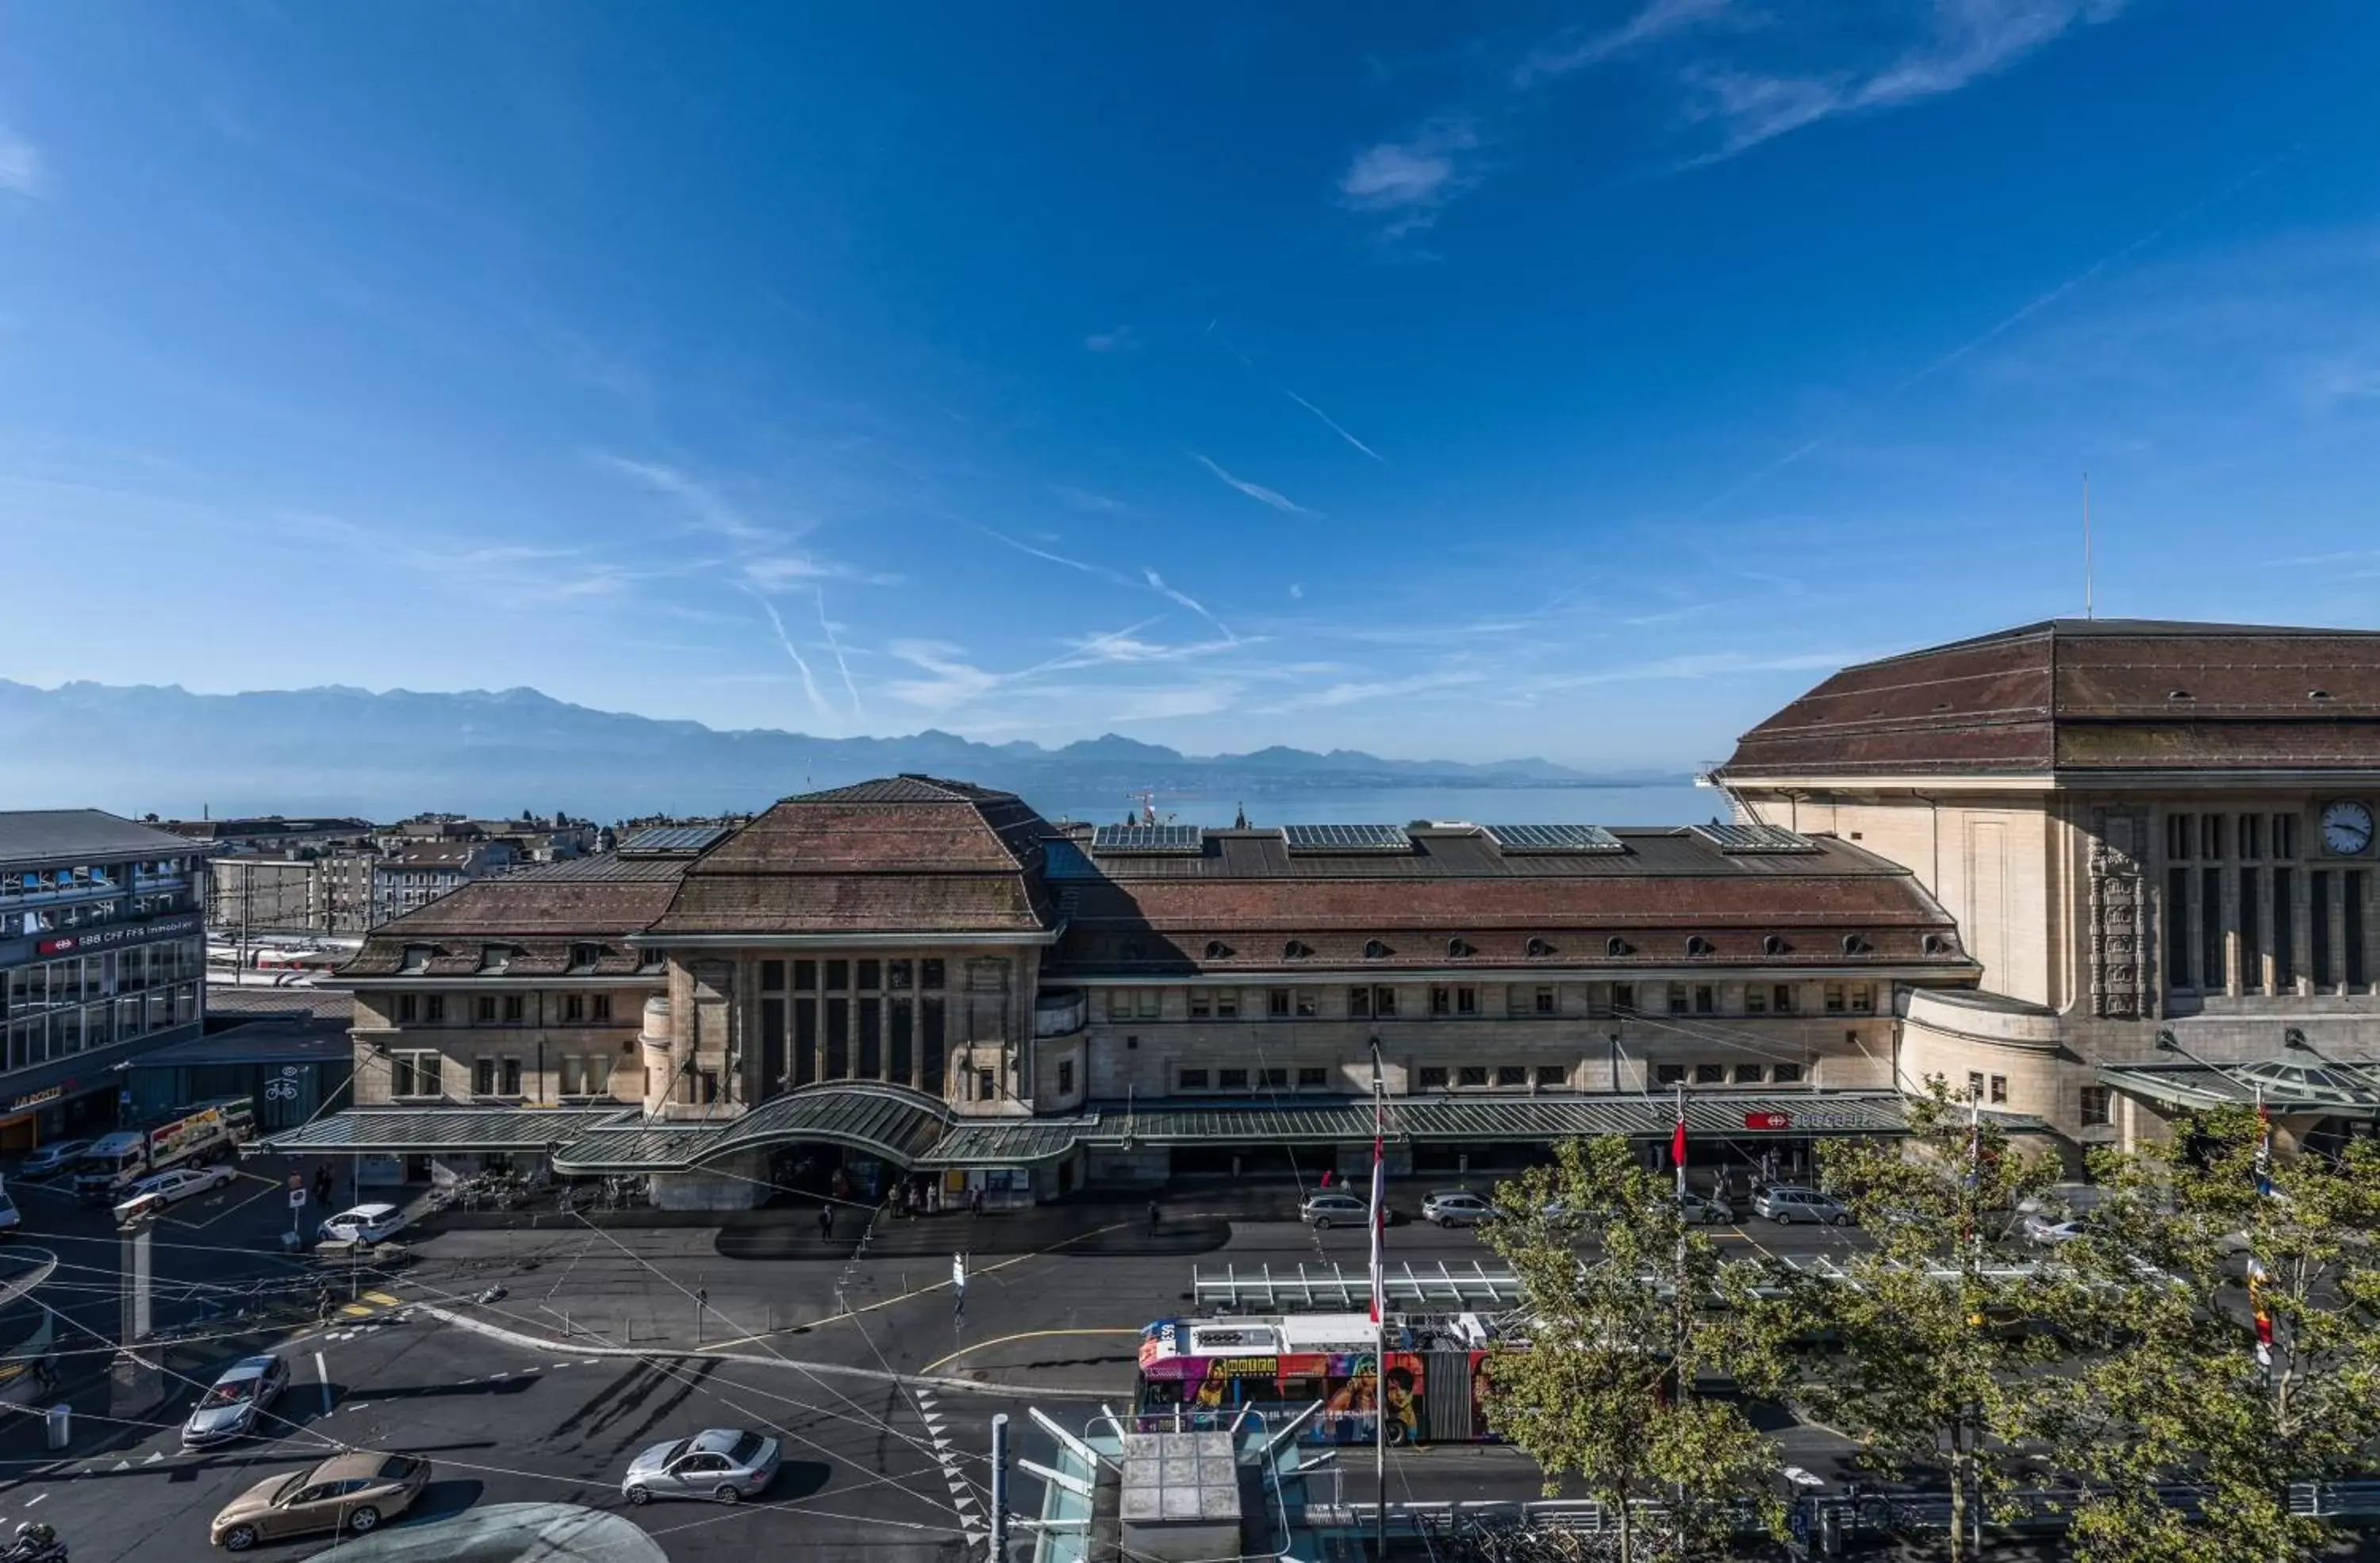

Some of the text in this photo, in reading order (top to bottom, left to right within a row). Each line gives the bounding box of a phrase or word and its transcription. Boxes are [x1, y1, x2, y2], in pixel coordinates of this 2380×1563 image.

[79, 934, 102, 946] SBB
[105, 930, 123, 943] CFF
[127, 927, 145, 939] FFS
